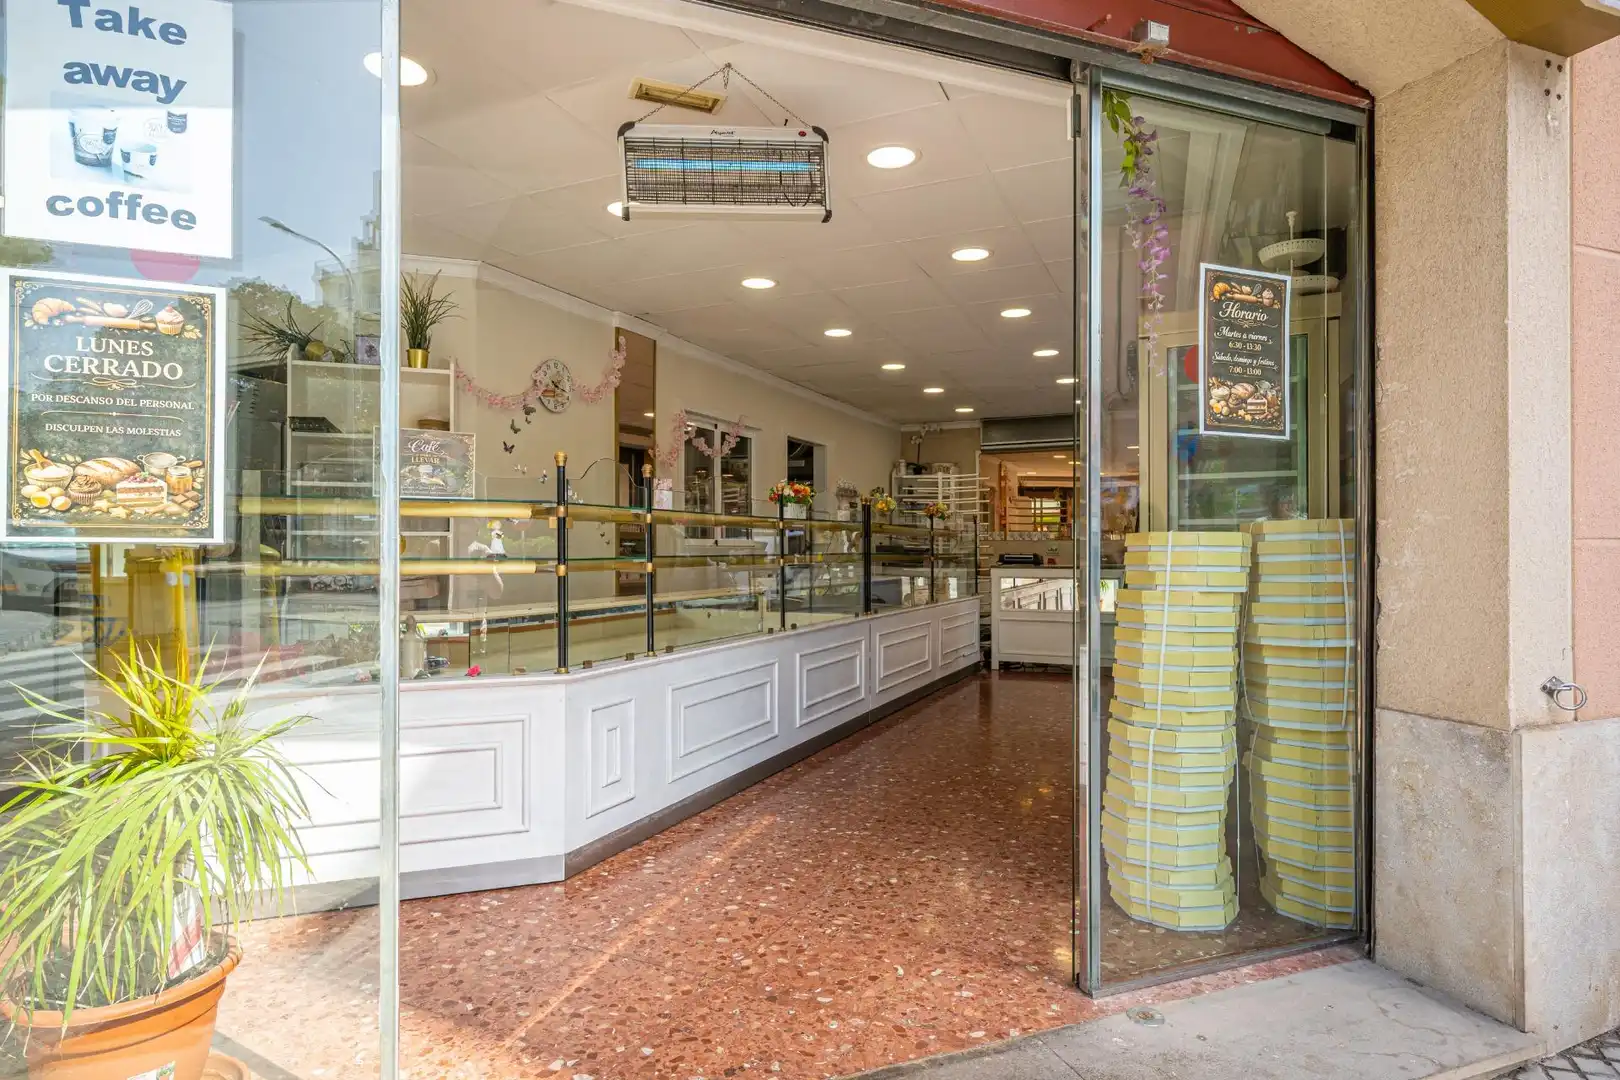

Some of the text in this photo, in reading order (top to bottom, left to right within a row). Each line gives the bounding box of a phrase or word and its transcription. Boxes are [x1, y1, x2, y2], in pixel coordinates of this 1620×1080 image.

[57, 0, 187, 45] Take
[63, 61, 187, 104] away
[46, 191, 197, 231] coffee
[1219, 301, 1268, 321] Horario
[1217, 326, 1241, 338] Martes
[76, 336, 154, 356] LUNES
[1228, 340, 1242, 349] 6:30
[44, 354, 183, 380] CERRADO
[1246, 367, 1262, 375] 13:00
[31, 393, 195, 410] POR DESCANSO DEL PERSONAL
[45, 423, 181, 437] DISCULPEN LAS MOLESTIAS
[408, 439, 440, 453] Café
